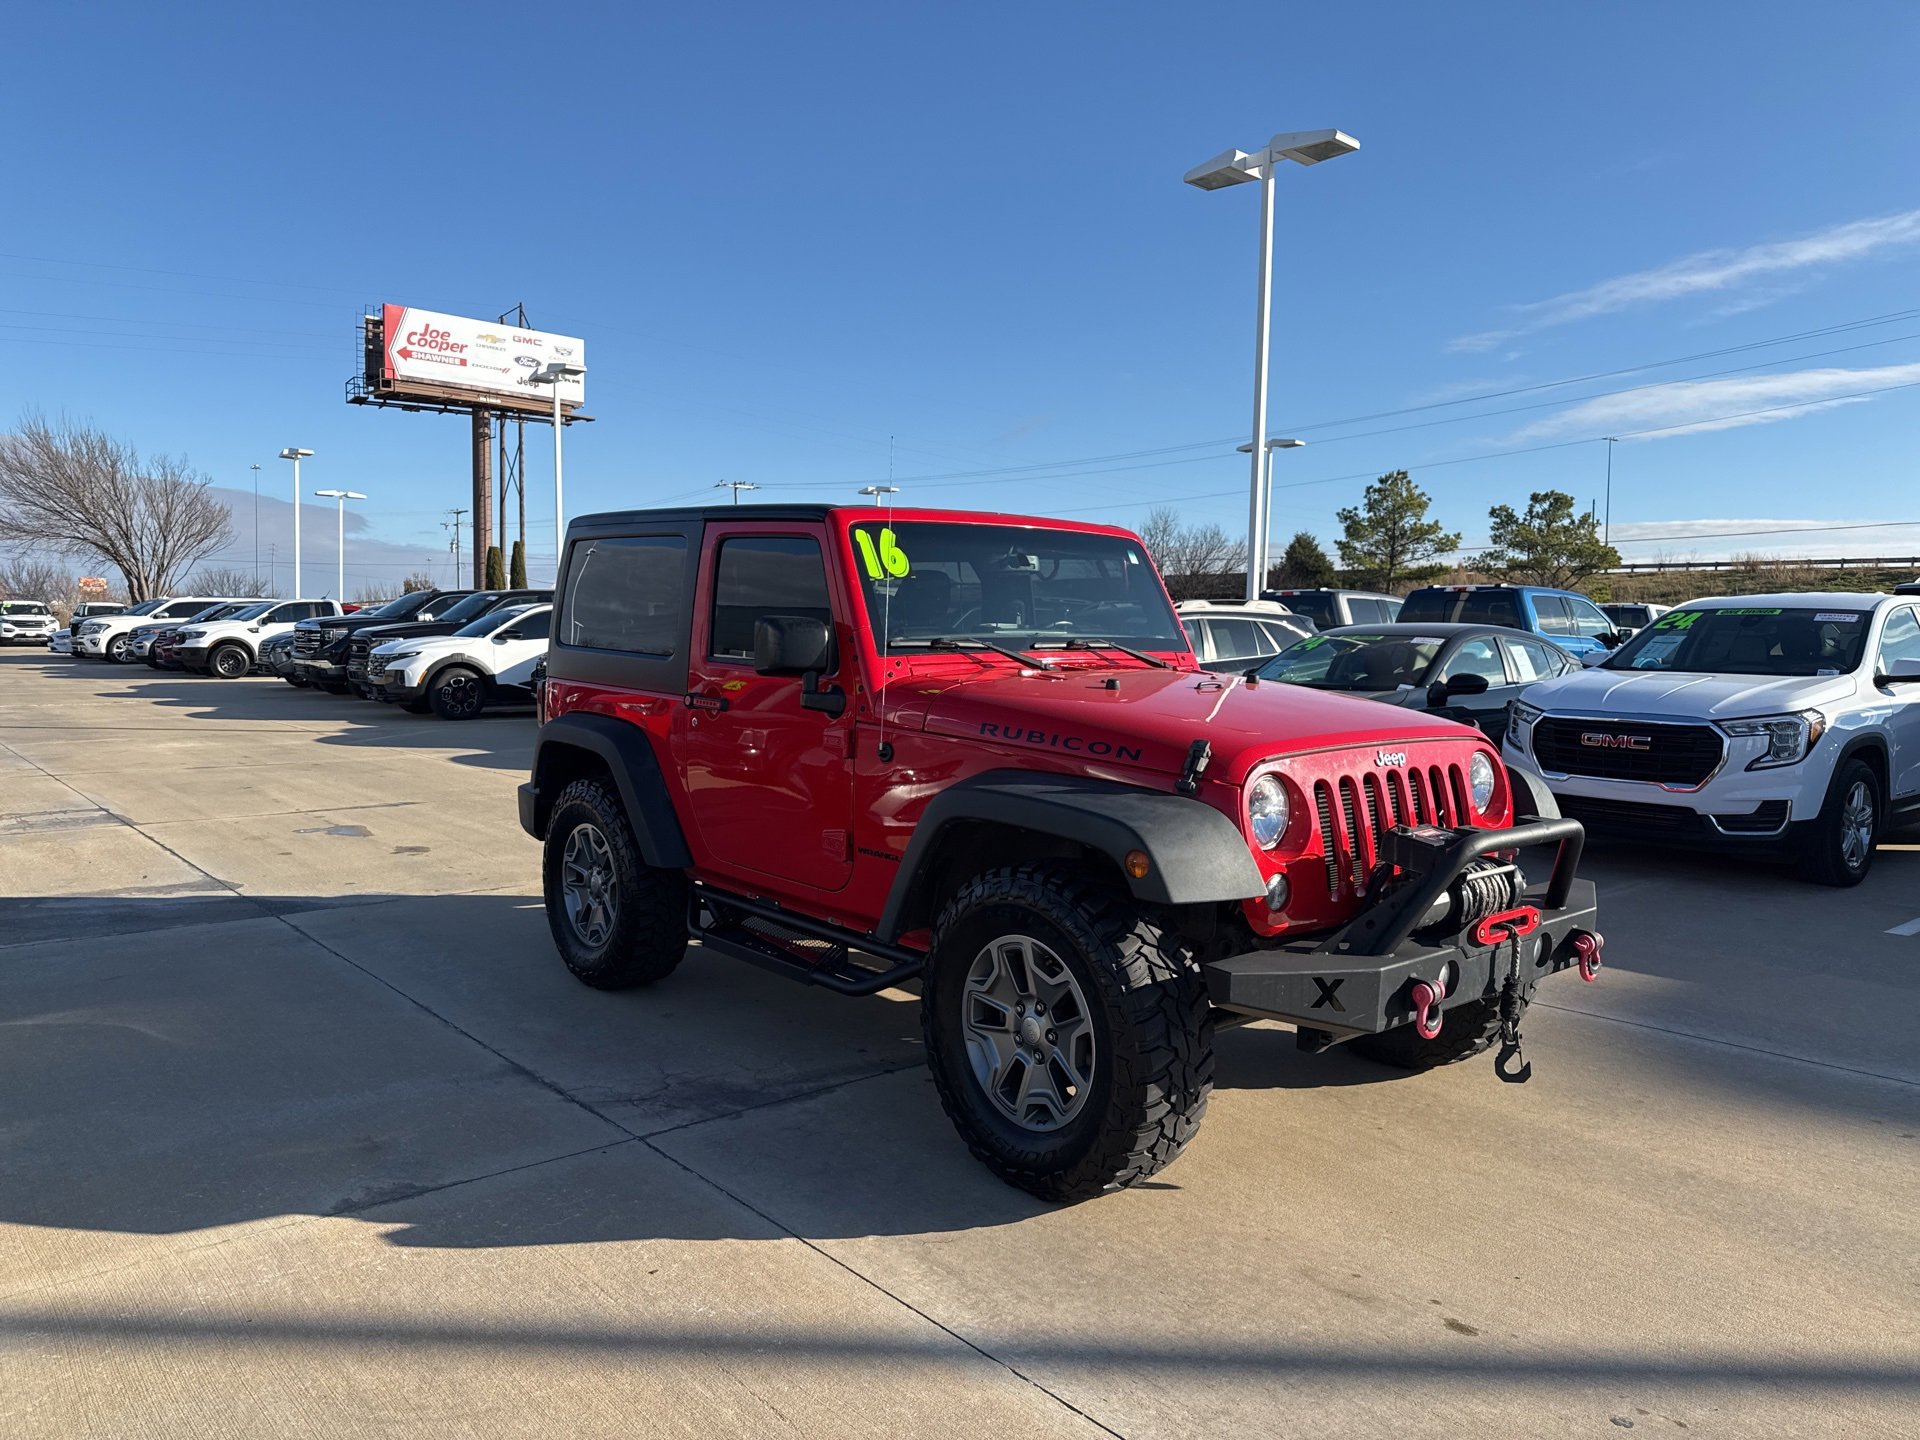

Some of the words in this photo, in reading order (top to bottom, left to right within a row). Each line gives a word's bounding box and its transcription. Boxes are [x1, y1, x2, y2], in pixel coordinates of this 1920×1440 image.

[419, 323, 451, 341] Joe
[512, 335, 543, 347] GMC
[406, 331, 469, 354] Cooper
[411, 350, 461, 366] SHAWNEE
[855, 528, 910, 579] 16
[1653, 612, 1704, 630] 24
[979, 722, 1143, 762] RUBICON
[1581, 732, 1651, 750] GMC
[1374, 750, 1406, 768] Jeep
